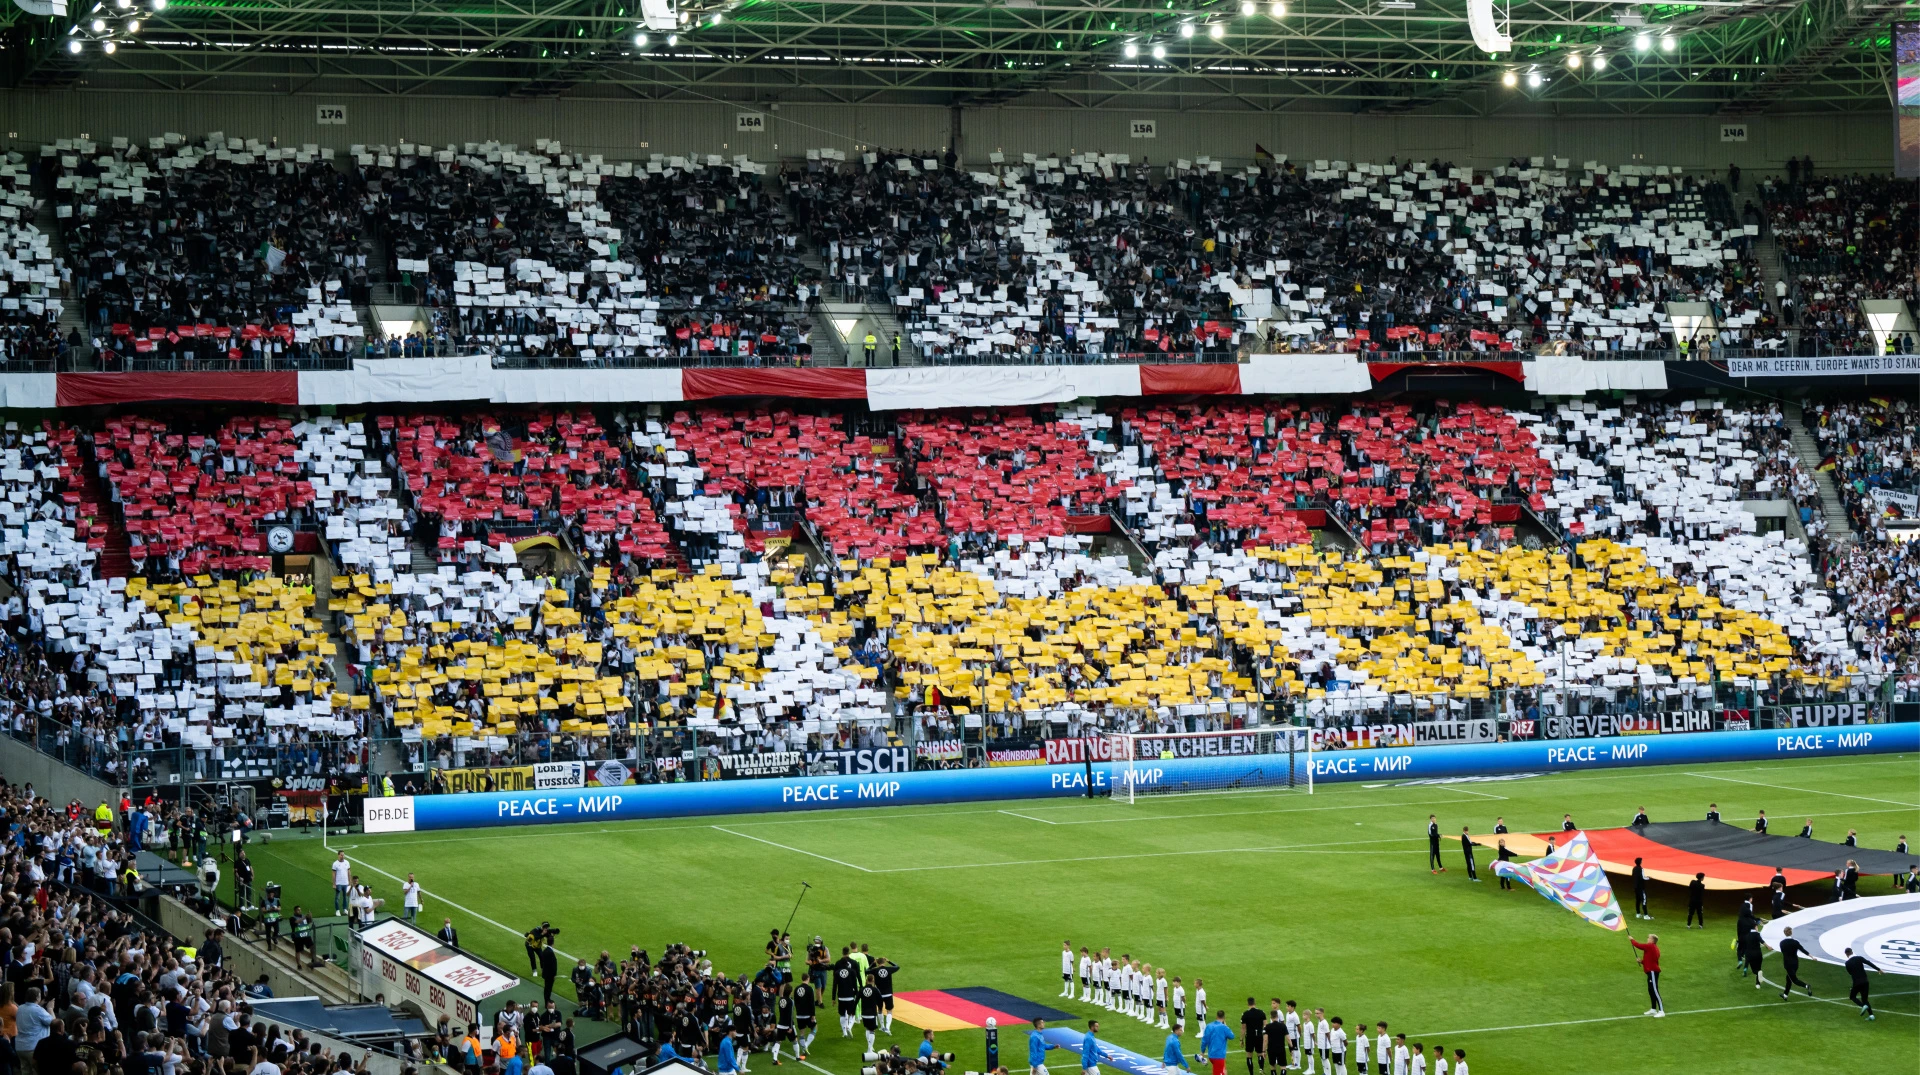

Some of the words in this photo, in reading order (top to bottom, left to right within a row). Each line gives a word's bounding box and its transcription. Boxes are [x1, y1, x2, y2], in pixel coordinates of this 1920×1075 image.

[320, 109, 343, 119] 17A
[740, 117, 761, 127] 16A
[1133, 124, 1153, 133] 15A
[1723, 128, 1745, 137] 14A
[1731, 361, 1753, 372] DEAR
[1756, 360, 1771, 372] MR.
[1816, 358, 1848, 370] EUROPE
[1851, 358, 1880, 370] WANTS
[1883, 358, 1893, 369] TO
[1872, 488, 1908, 500] Fanclub
[1660, 710, 1711, 733] LEIHA
[1791, 703, 1866, 728] FUPPE
[1311, 722, 1414, 750] GOLTERN
[1416, 723, 1466, 741] HALLE
[1480, 722, 1493, 738] S.
[1510, 720, 1534, 734] DIEZ
[1044, 736, 1135, 763] RATINGEN
[1140, 735, 1256, 757] BRACHELEN
[1777, 734, 1823, 751] PEACE
[1838, 732, 1873, 748] МИР
[717, 751, 801, 770] WILLICHER
[806, 747, 909, 777] KETSCH
[991, 749, 1040, 762] SCHÖNBRONN
[1548, 746, 1596, 763] PEACE
[1611, 743, 1648, 760] МИР
[537, 765, 564, 774] LORD
[736, 765, 790, 776] FOHLEN
[1306, 758, 1357, 776] PEACE
[1374, 755, 1412, 772] МИР
[285, 775, 326, 792] SpVgg
[538, 776, 581, 787] FUSSECK
[782, 784, 840, 803] PEACE
[858, 781, 900, 799] МИР
[369, 807, 409, 821] DFB.DE
[498, 798, 558, 817] PEACE
[578, 795, 623, 813] МИР
[377, 930, 420, 951] ERGO
[382, 960, 397, 982] ERGO
[445, 966, 492, 988] ERGO
[405, 972, 421, 996] ERGO
[502, 981, 516, 990] ERGO
[429, 985, 446, 1010] ERGO
[481, 989, 496, 999] ERGO
[456, 999, 473, 1024] ERGO
